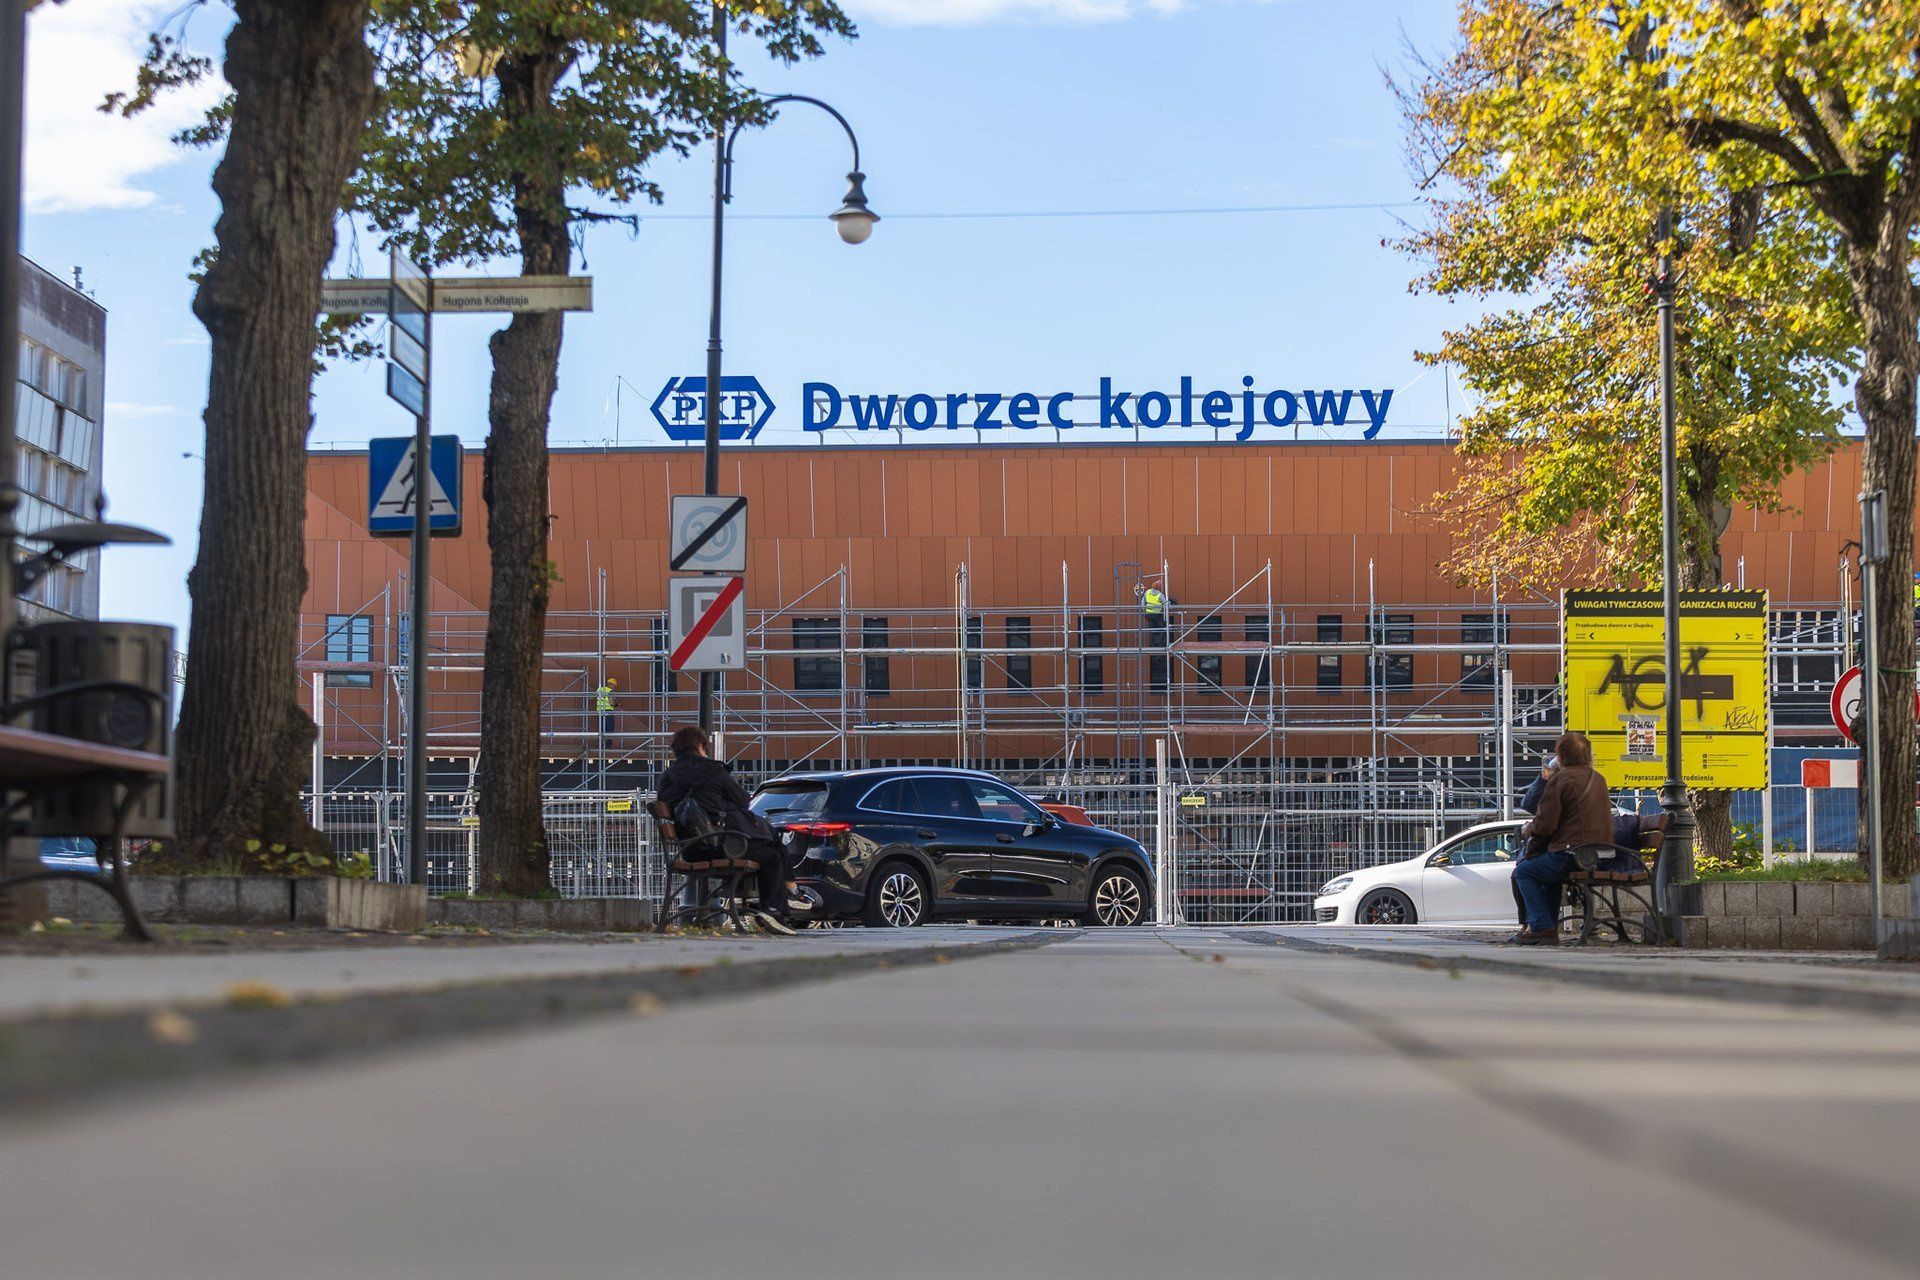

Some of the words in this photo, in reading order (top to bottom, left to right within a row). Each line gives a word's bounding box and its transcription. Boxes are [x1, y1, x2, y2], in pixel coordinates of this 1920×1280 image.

[442, 296, 482, 308] Hugona
[803, 382, 1074, 431] Dworzec
[1100, 375, 1394, 441] kolejowy
[1574, 601, 1607, 609] UWAGA!
[1680, 601, 1726, 609] GANIZACJA
[1727, 601, 1757, 609] RUCHU
[1624, 774, 1667, 783] Przepraszamy
